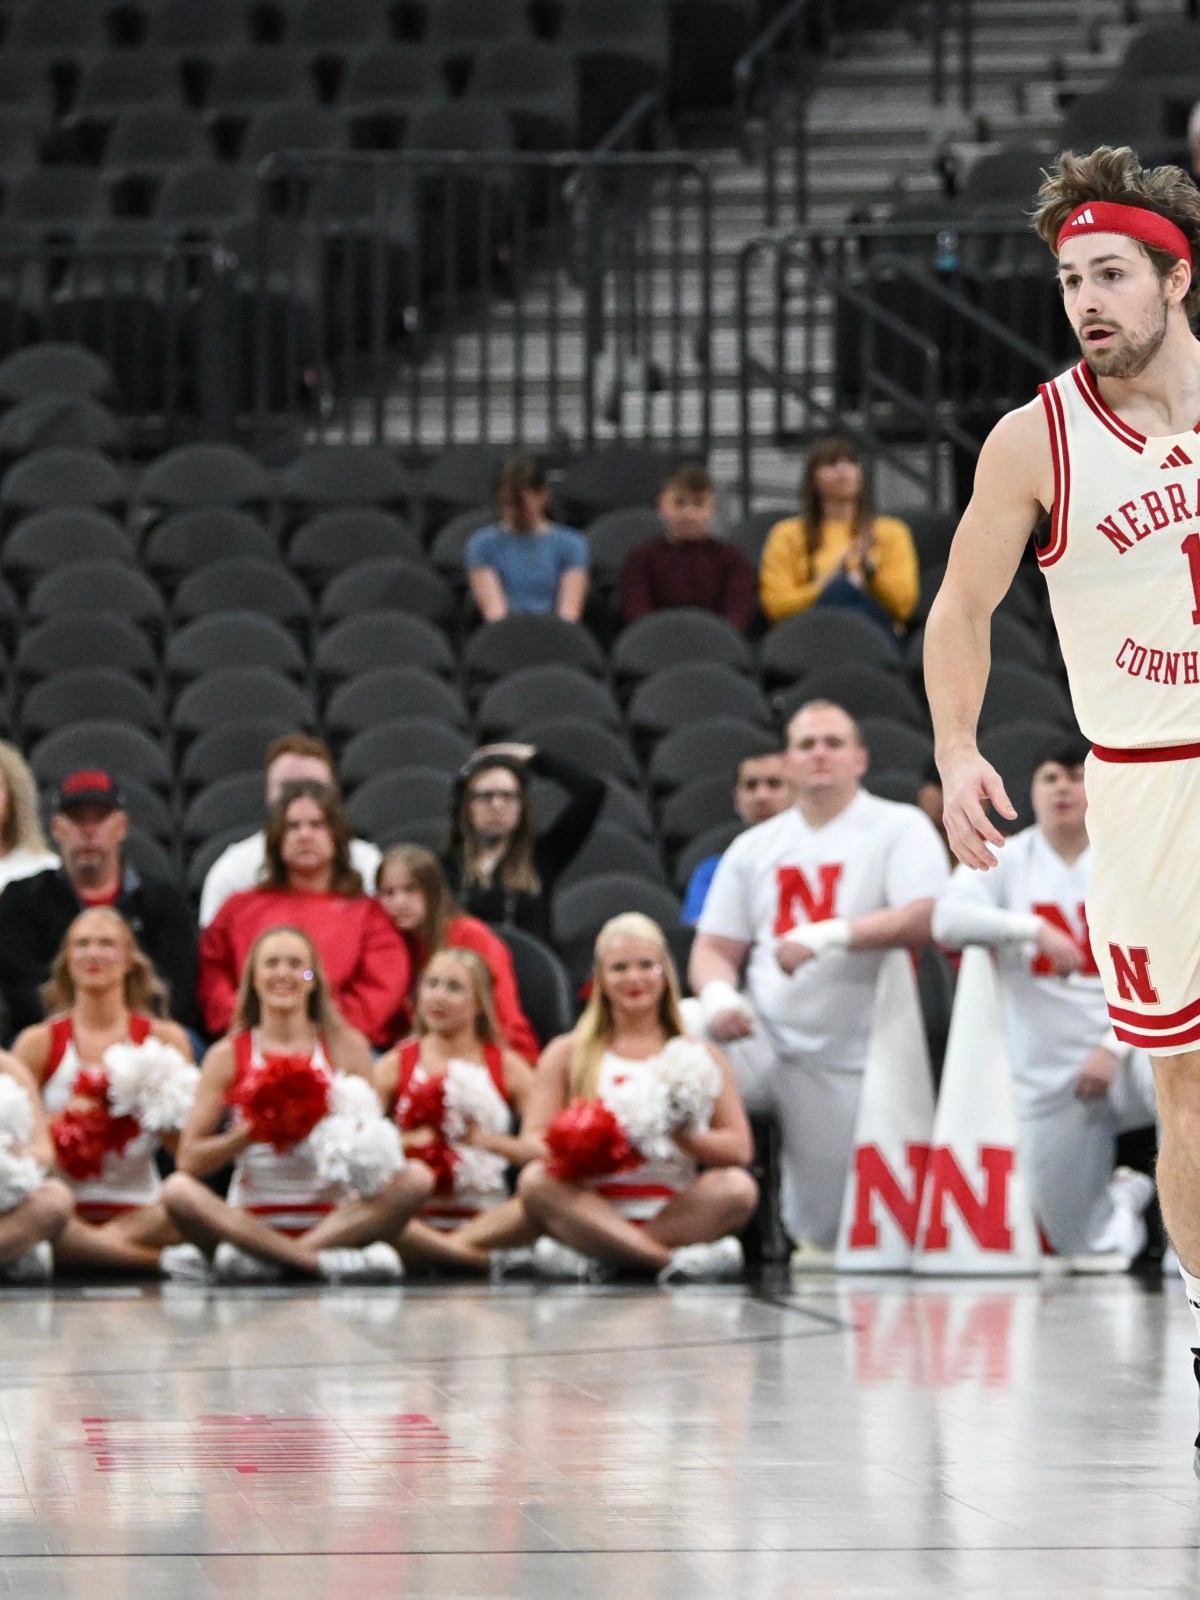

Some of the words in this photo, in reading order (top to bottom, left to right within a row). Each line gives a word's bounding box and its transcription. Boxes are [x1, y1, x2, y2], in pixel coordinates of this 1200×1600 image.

[773, 862, 844, 938] N
[1108, 941, 1161, 1005] N
[848, 1142, 932, 1252] N
[922, 1144, 1015, 1254] N
